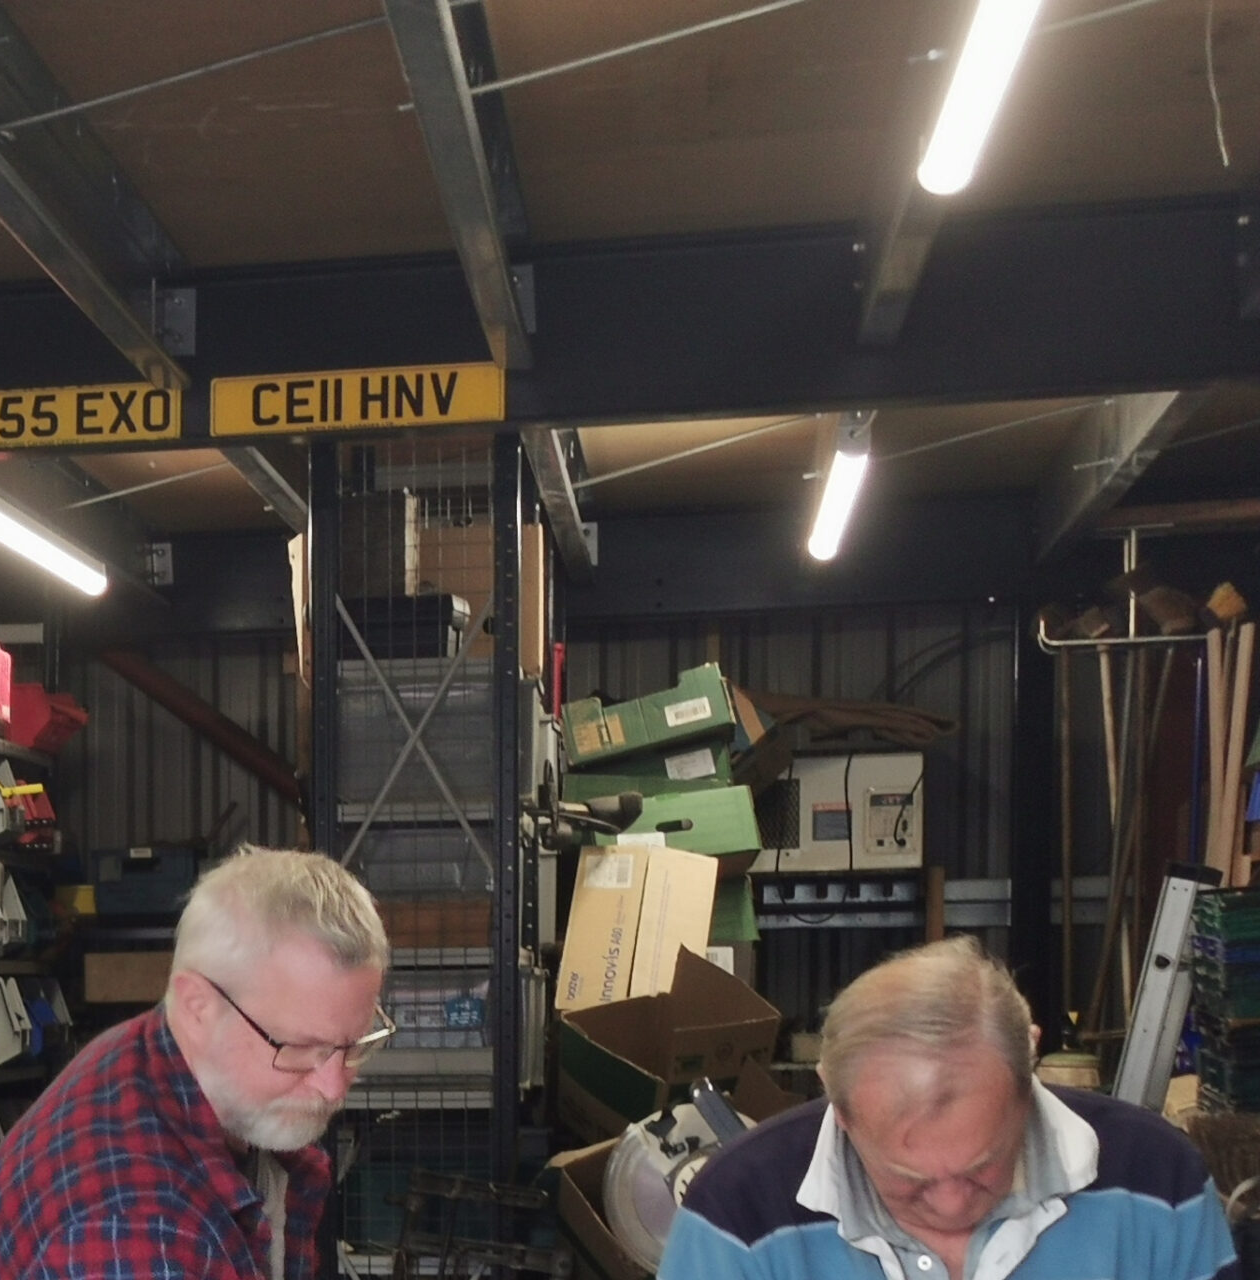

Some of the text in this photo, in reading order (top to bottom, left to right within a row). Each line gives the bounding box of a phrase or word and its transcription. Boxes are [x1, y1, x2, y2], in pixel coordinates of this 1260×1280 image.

[75, 388, 172, 435] EXO
[251, 371, 459, 427] CE11 HNV
